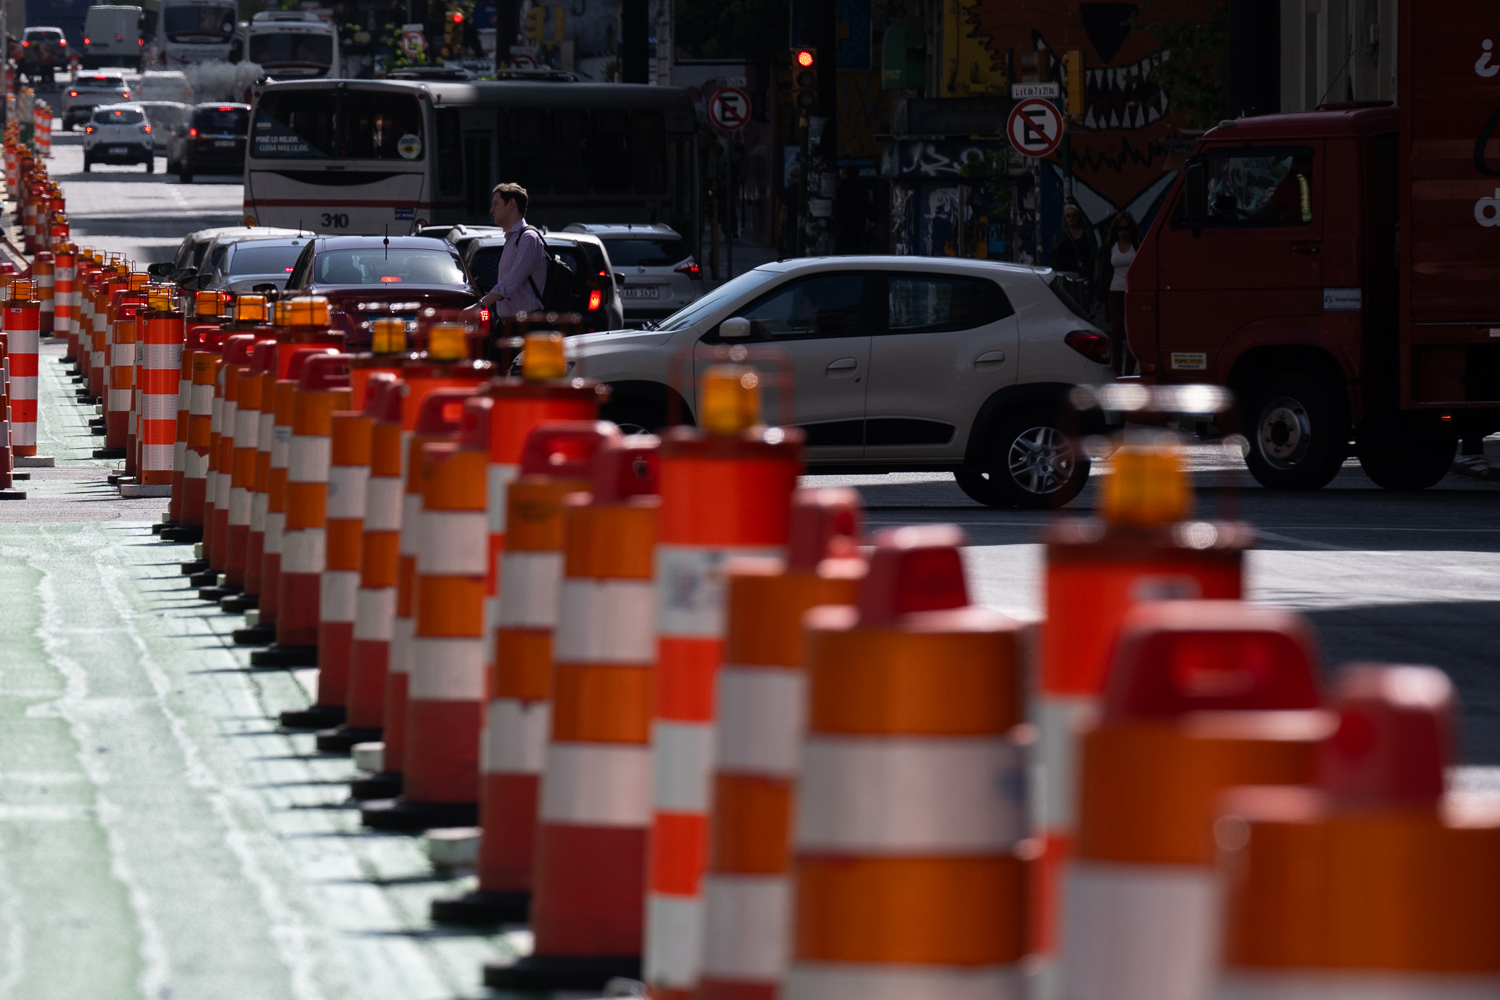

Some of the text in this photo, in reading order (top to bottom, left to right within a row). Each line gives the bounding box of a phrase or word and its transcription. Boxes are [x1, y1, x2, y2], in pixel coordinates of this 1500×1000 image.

[1028, 86, 1033, 96] de
[1043, 86, 1048, 95] 21
[255, 134, 270, 143] PONÉ
[270, 135, 278, 143] LO
[277, 143, 291, 152] MÁS
[321, 212, 349, 228] 310
